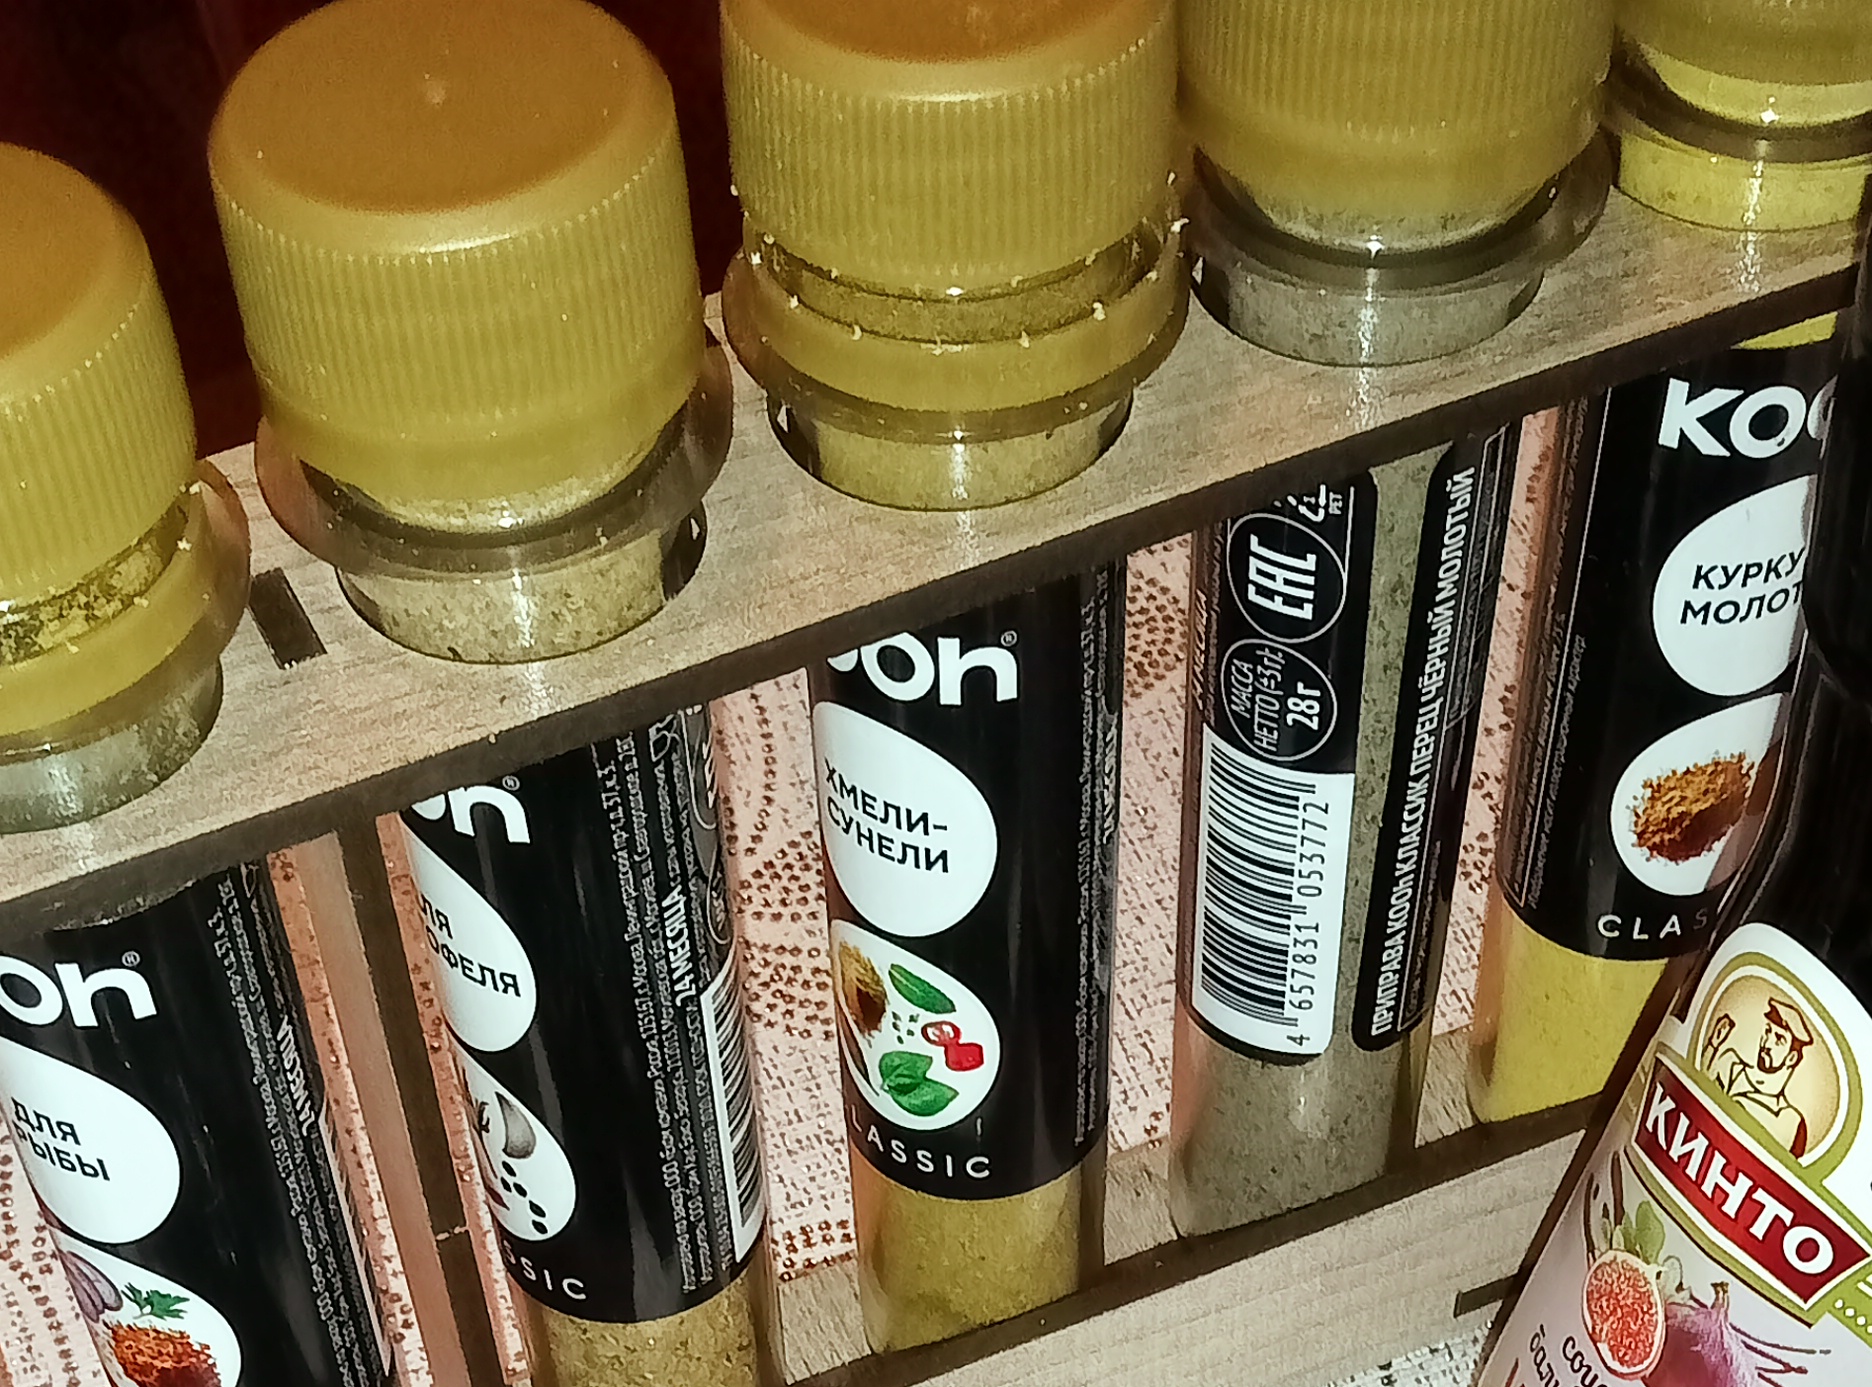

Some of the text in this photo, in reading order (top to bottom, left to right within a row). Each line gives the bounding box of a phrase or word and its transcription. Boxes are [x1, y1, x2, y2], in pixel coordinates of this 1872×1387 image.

[1435, 467, 1476, 602] МОЛОТЫЙ
[1692, 547, 1805, 590] КУРКУ
[1680, 580, 1803, 625] МОЛОТ
[1418, 601, 1455, 696] ЧЁРНЫЙ
[1231, 659, 1253, 718] МАССА
[1410, 697, 1444, 776] ПЕРЕЦ
[824, 756, 948, 836] ХМЕЛИ-
[1395, 780, 1430, 880] КЛАССИК
[827, 796, 949, 874] СУНЕЛИ
[426, 925, 521, 998] ОФЕЛЯ
[661, 884, 692, 980] МЕСЯЦА
[1286, 802, 1329, 1047] 4 657831 053772
[1597, 907, 1709, 940] CLAS
[675, 974, 698, 1007] 24
[1371, 930, 1406, 1036] ПРИПРАВА
[11, 1096, 82, 1146] ДЛЯ
[12, 1119, 110, 1182] РЫБЫ
[850, 1104, 990, 1178] LASSIC
[1645, 1081, 1834, 1275] КИНТО
[503, 1239, 587, 1300] SSIC
